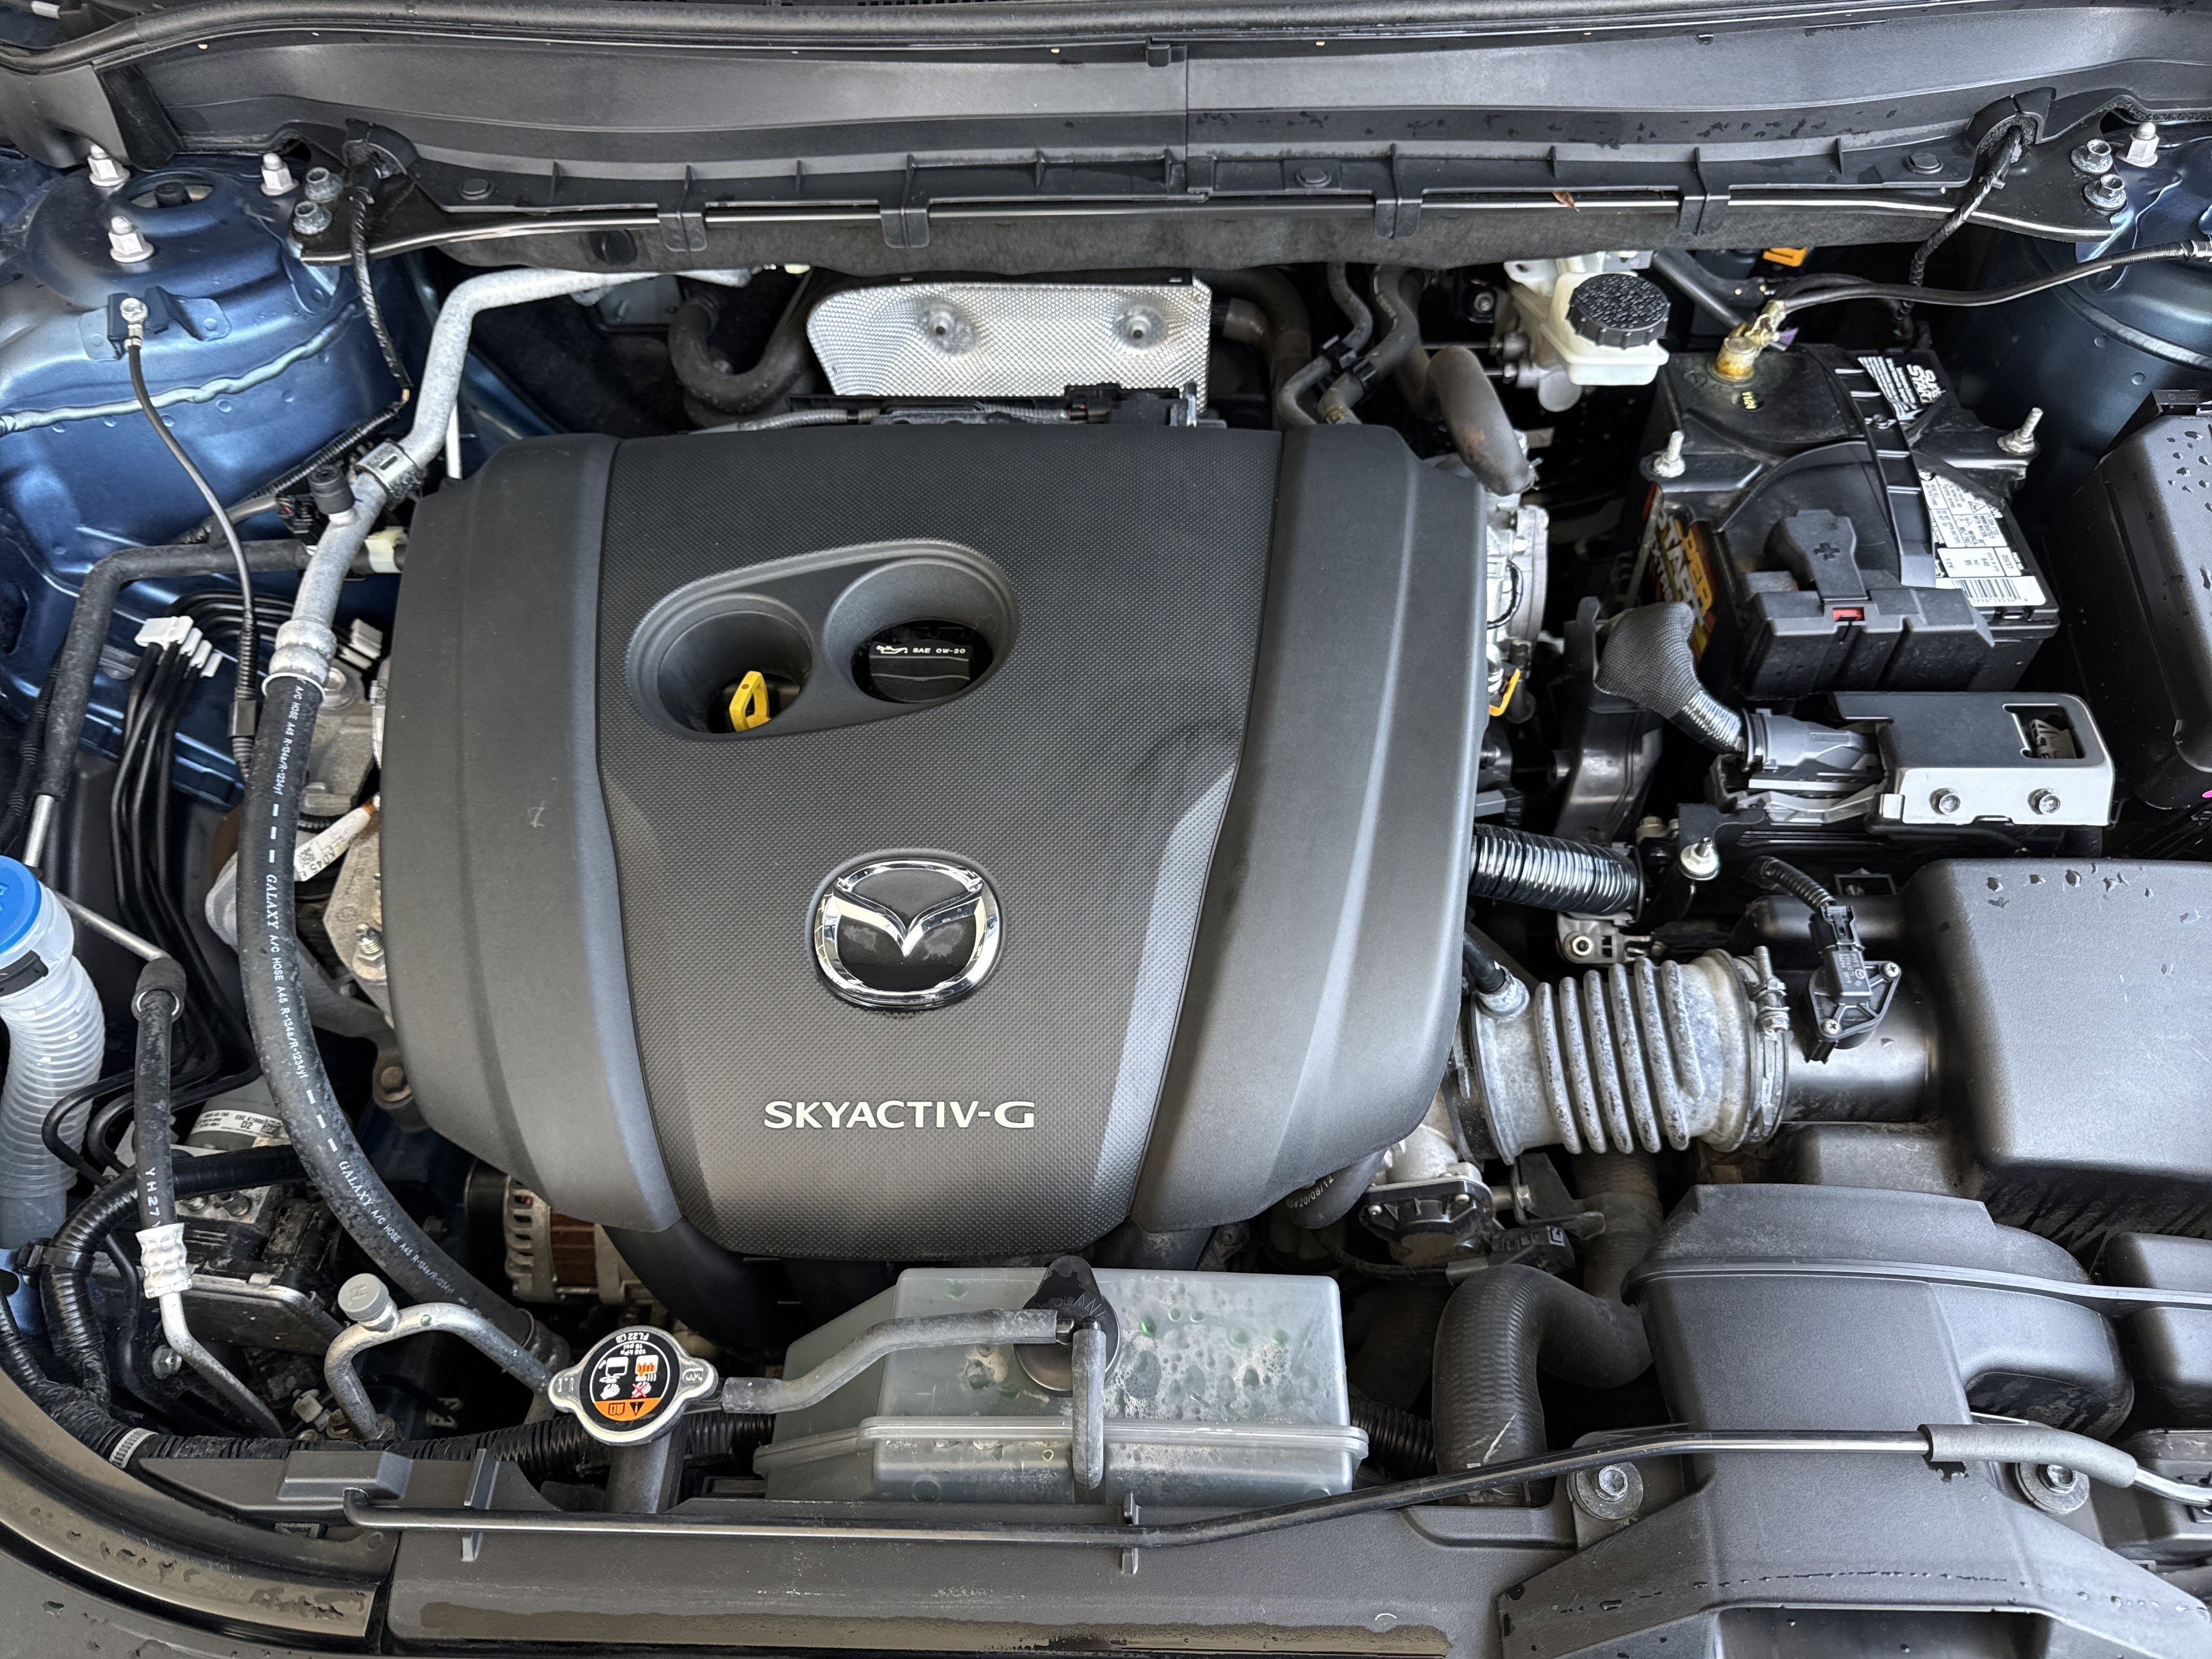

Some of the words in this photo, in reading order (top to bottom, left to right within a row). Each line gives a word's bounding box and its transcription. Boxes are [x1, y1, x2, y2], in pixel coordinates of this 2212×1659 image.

[293, 685, 304, 700] A/C
[289, 701, 301, 720] HOSE
[266, 873, 280, 930] GALAXY
[269, 934, 280, 953] A/C
[272, 957, 284, 981] HOSE
[280, 1007, 309, 1079] R-134a/R-1234yf
[764, 1099, 1035, 1129] SKYACTIV-G
[338, 1160, 374, 1207] GALAXY
[370, 1209, 386, 1225] A/C
[383, 1223, 402, 1244] HOSE
[627, 1332, 650, 1341] FL22
